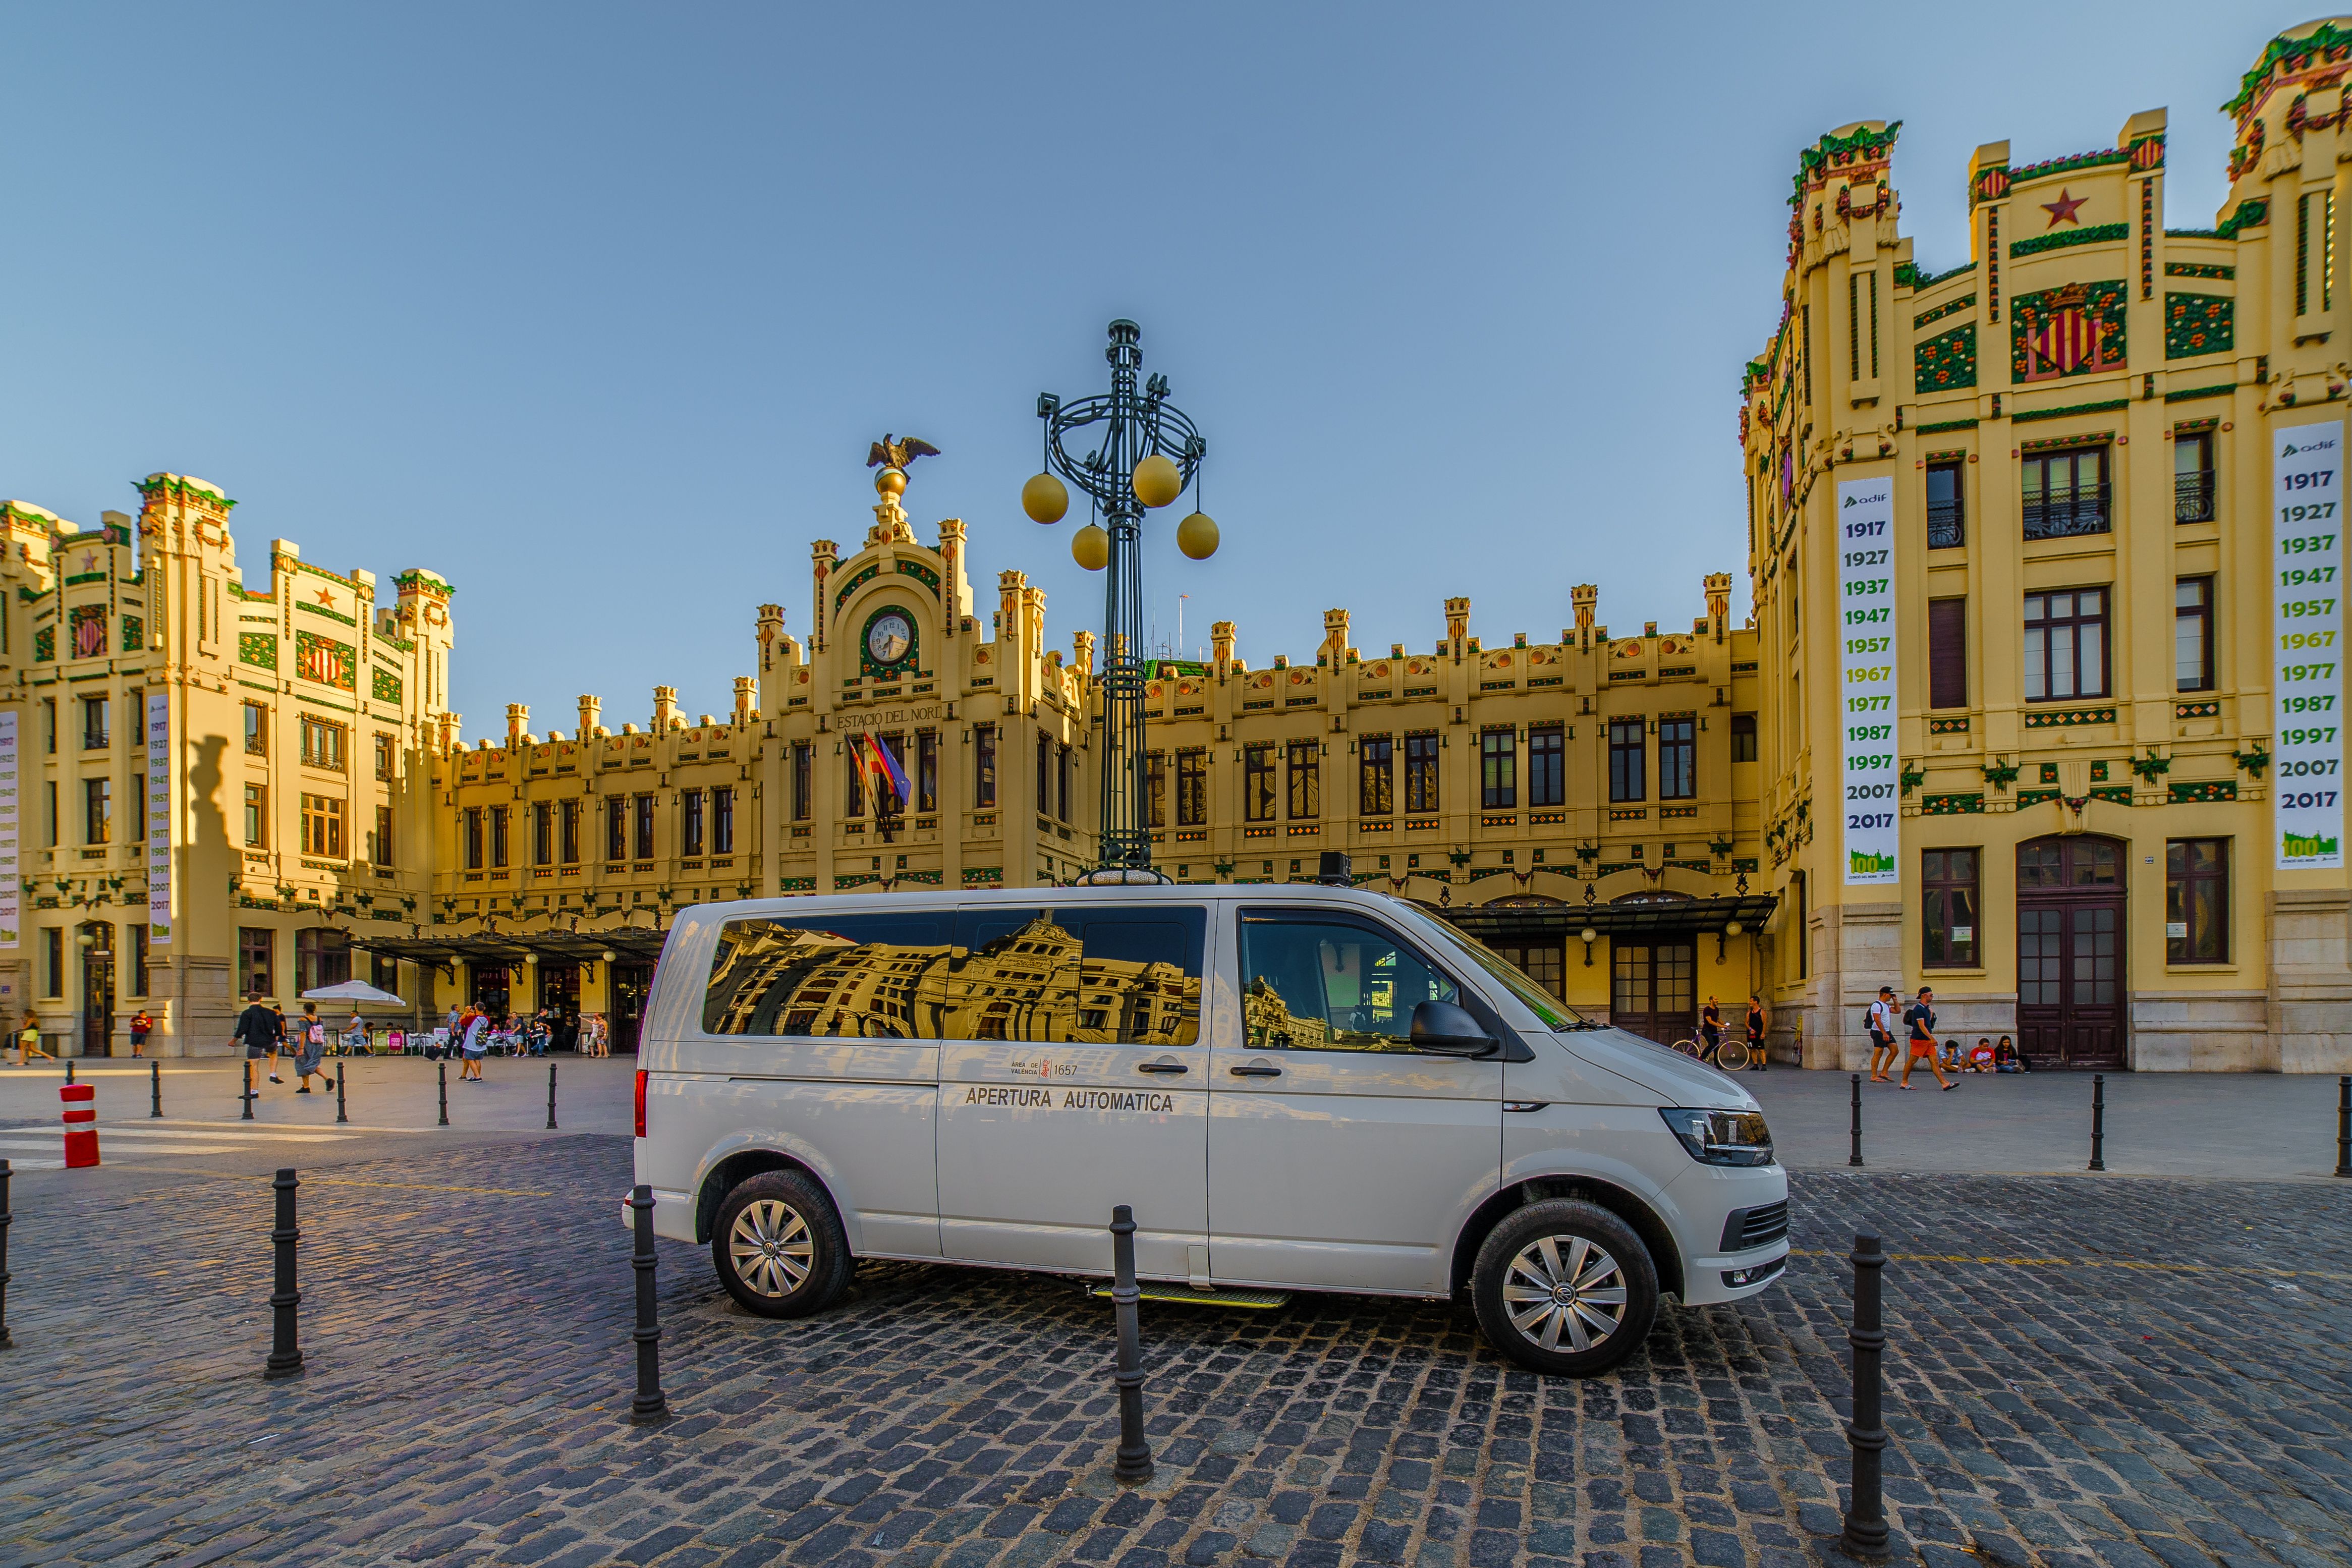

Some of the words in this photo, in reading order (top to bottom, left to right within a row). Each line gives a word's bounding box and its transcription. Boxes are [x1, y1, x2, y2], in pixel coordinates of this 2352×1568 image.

[2301, 439, 2336, 452] adif
[2284, 470, 2334, 490] 1917
[1859, 493, 1887, 503] adif
[2281, 502, 2336, 522] 1927
[1846, 521, 1886, 538] 1917
[2281, 534, 2336, 554] 1937
[1844, 550, 1888, 567] 1927
[2280, 567, 2337, 586] 1947
[1845, 579, 1889, 596] 1937
[1845, 608, 1890, 625] 1947
[2281, 599, 2336, 618] 1957
[1846, 637, 1890, 654] 1957
[2280, 631, 2336, 650] 1967
[1846, 666, 1891, 683] 1967
[2282, 663, 2335, 682] 1977
[1848, 696, 1891, 712] 1977
[2282, 695, 2336, 713] 1987
[837, 709, 883, 729] ESTACIÓ
[885, 710, 909, 724] DEL
[911, 706, 942, 721] NORD
[1849, 725, 1891, 741] 1987
[2281, 727, 2337, 745] 1997
[1848, 755, 1893, 770] 1997
[2280, 759, 2338, 777] 2007
[1847, 784, 1895, 800] 2007
[2282, 792, 2337, 809] 2017
[1849, 813, 1894, 829] 2017
[2282, 839, 2318, 857] 100
[1849, 858, 1878, 874] 100
[1054, 1065, 1078, 1076] 1657
[966, 1087, 1052, 1107] APERTURA
[1063, 1091, 1173, 1112] AUTOMATICA
